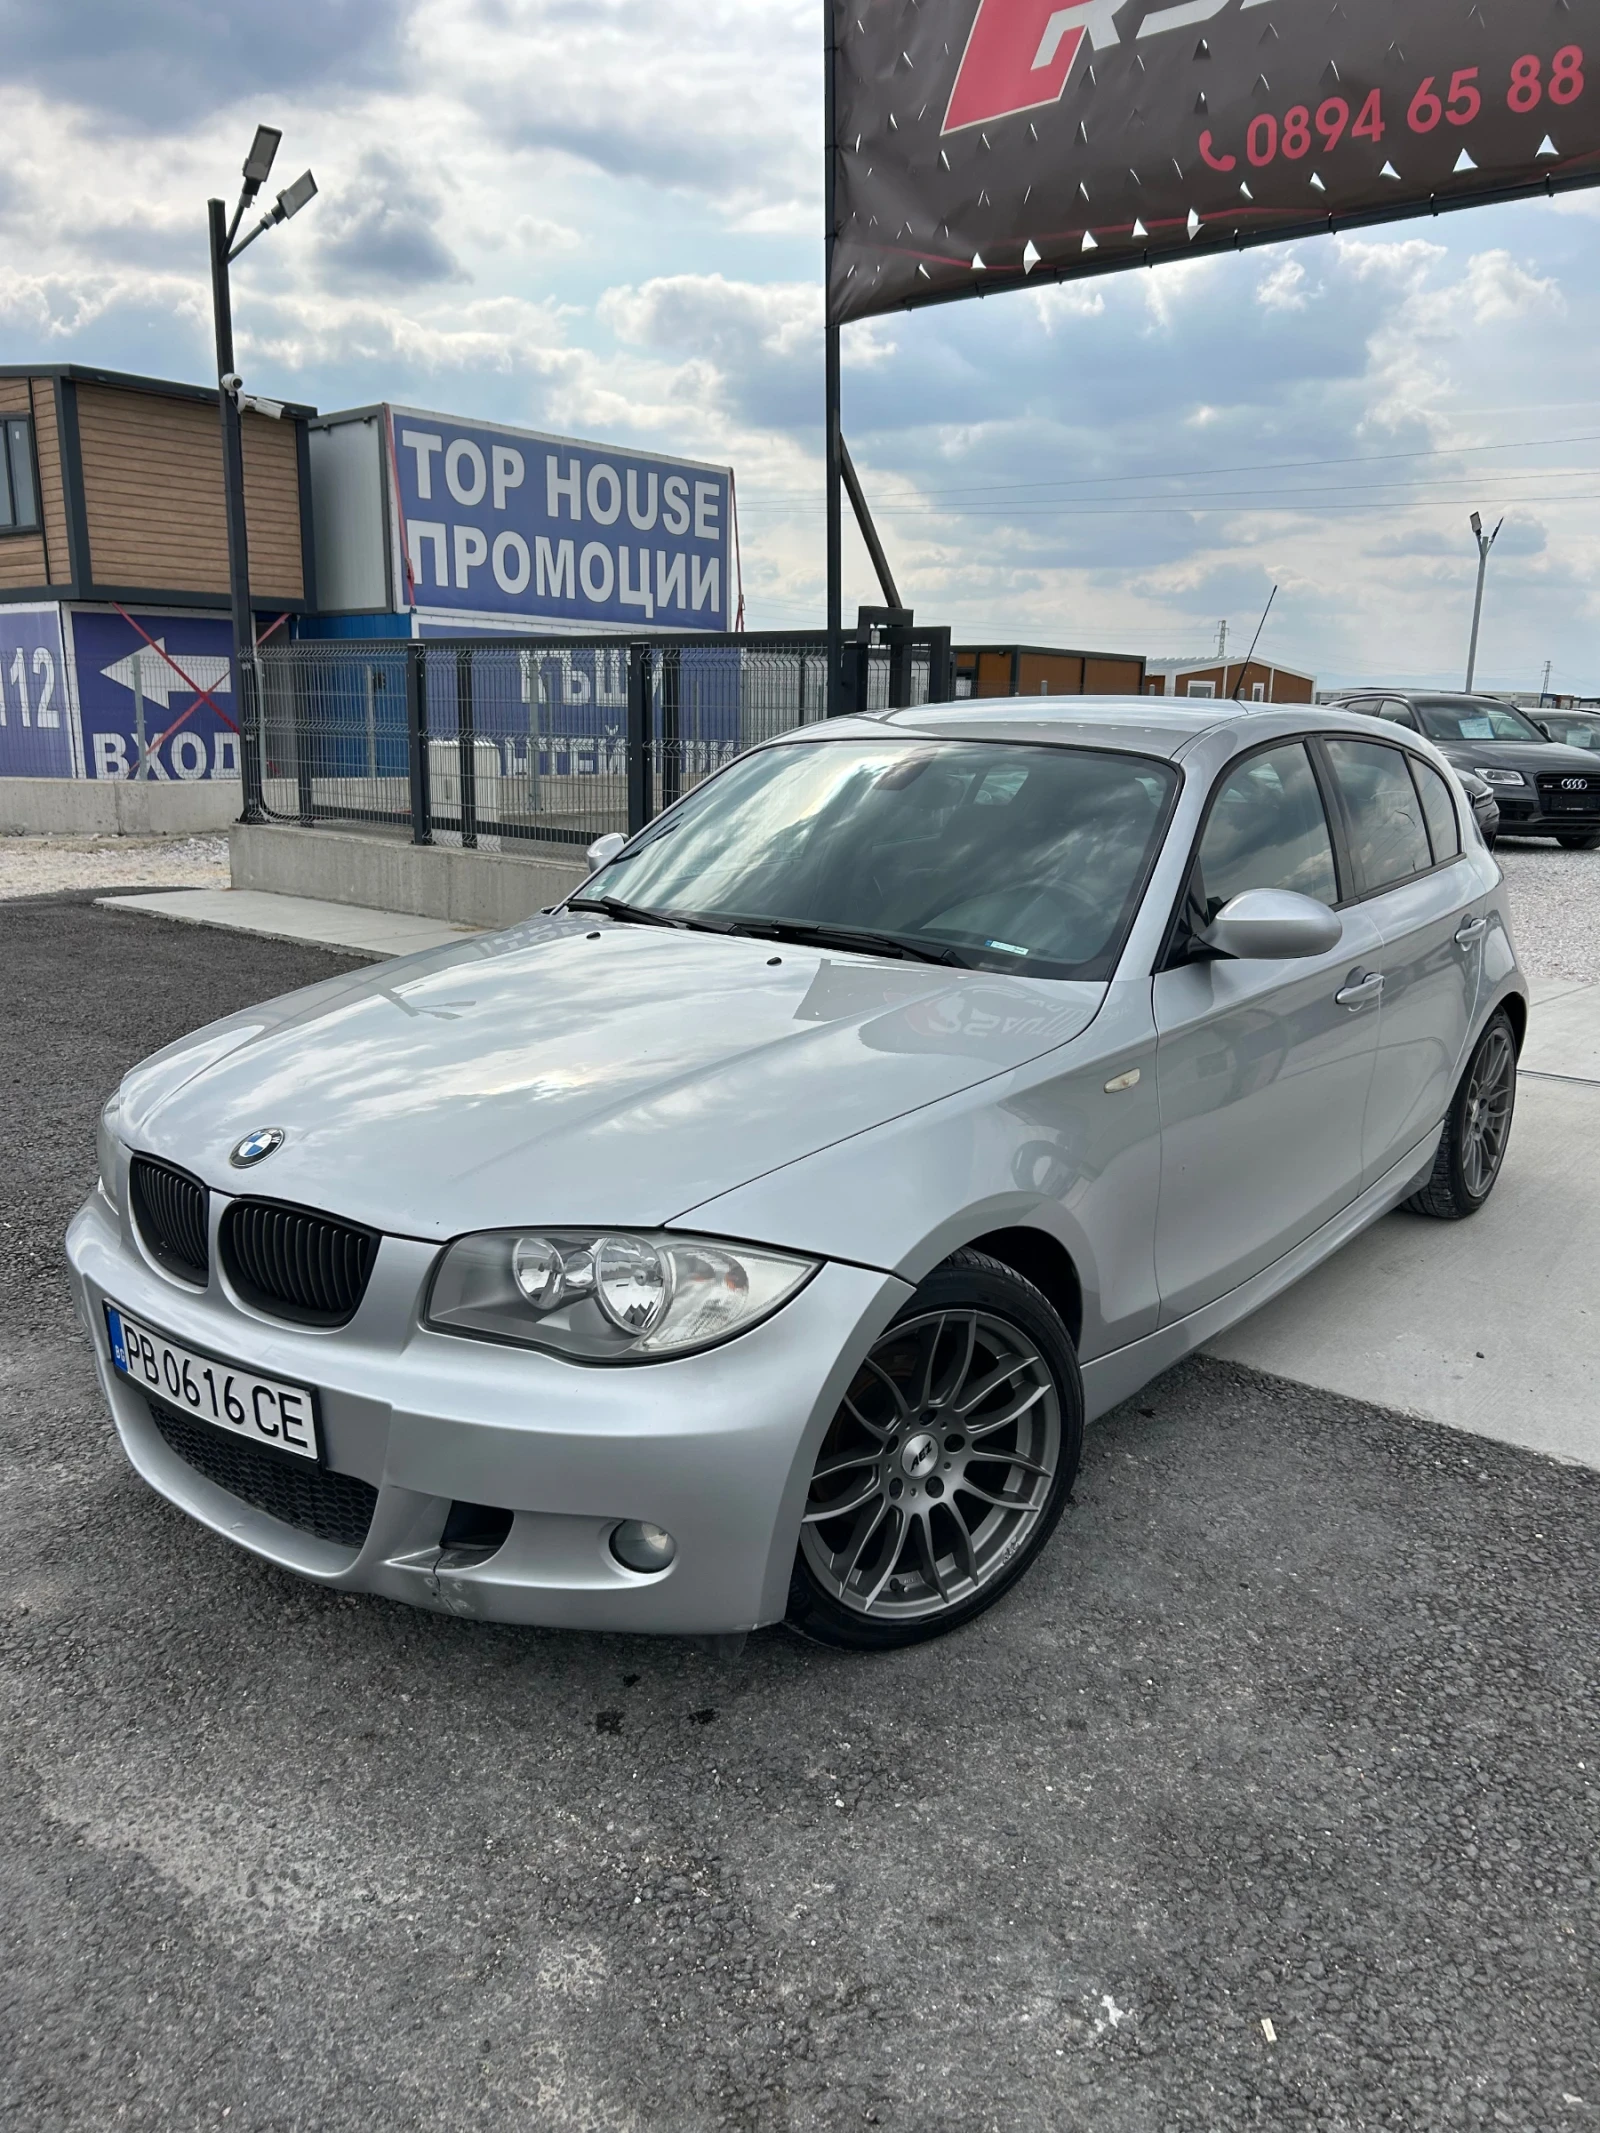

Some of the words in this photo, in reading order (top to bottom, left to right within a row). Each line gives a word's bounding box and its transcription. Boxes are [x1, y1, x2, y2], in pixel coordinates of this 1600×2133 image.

[1246, 88, 1385, 167] 0894
[1407, 65, 1481, 134] 65
[1506, 44, 1585, 113] 88
[402, 429, 525, 510] TOP
[546, 455, 720, 540] HOUSE
[406, 518, 720, 619] ПРОМОЦИИ
[93, 731, 241, 780] ВХОД
